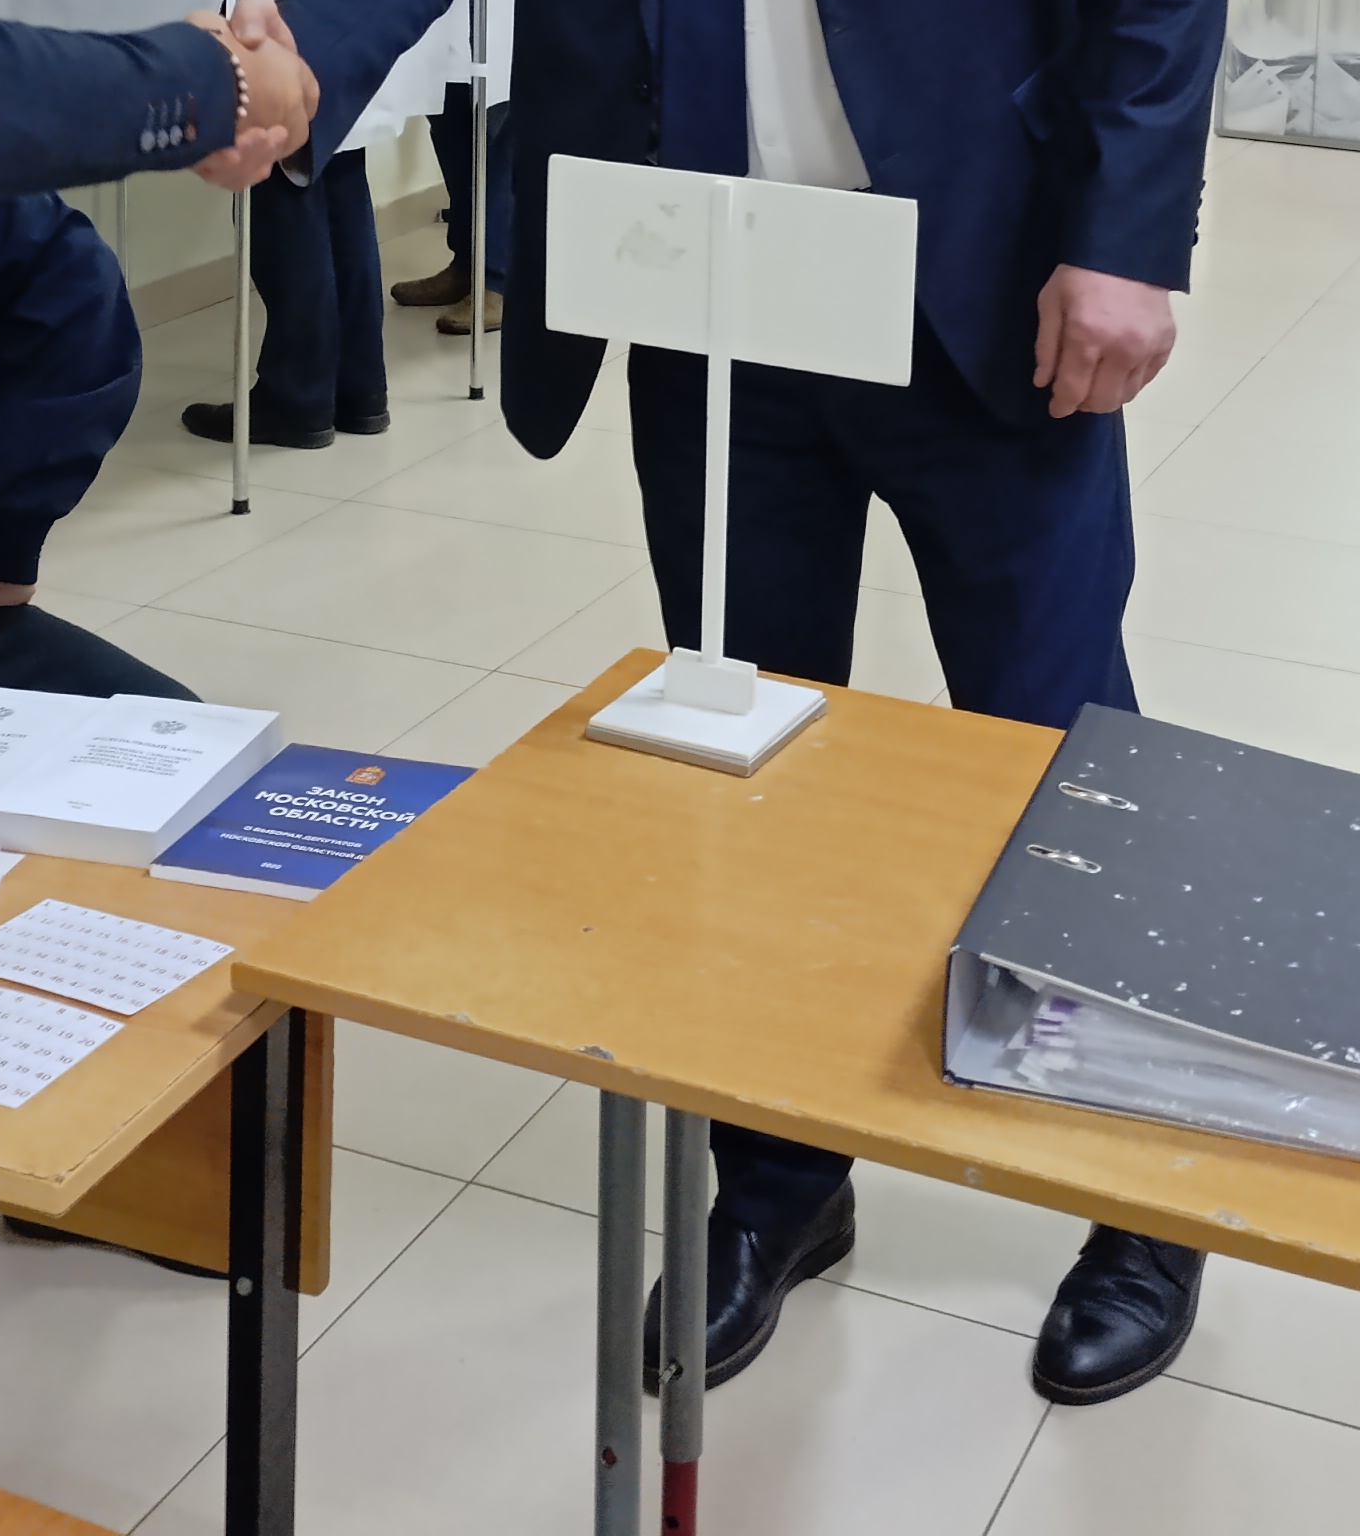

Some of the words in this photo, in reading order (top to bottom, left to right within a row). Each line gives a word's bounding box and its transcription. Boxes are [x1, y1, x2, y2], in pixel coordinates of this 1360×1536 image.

[254, 790, 417, 825] МОСКОВСКОЙ
[305, 786, 388, 807] ЗАКОН
[268, 806, 381, 832] ОБЛАСТИ
[219, 831, 292, 849] МОСКОВСКОЙ
[290, 843, 356, 860] ОБЛАСТНОЙ
[301, 834, 363, 849] ДЕПУТАТОВ
